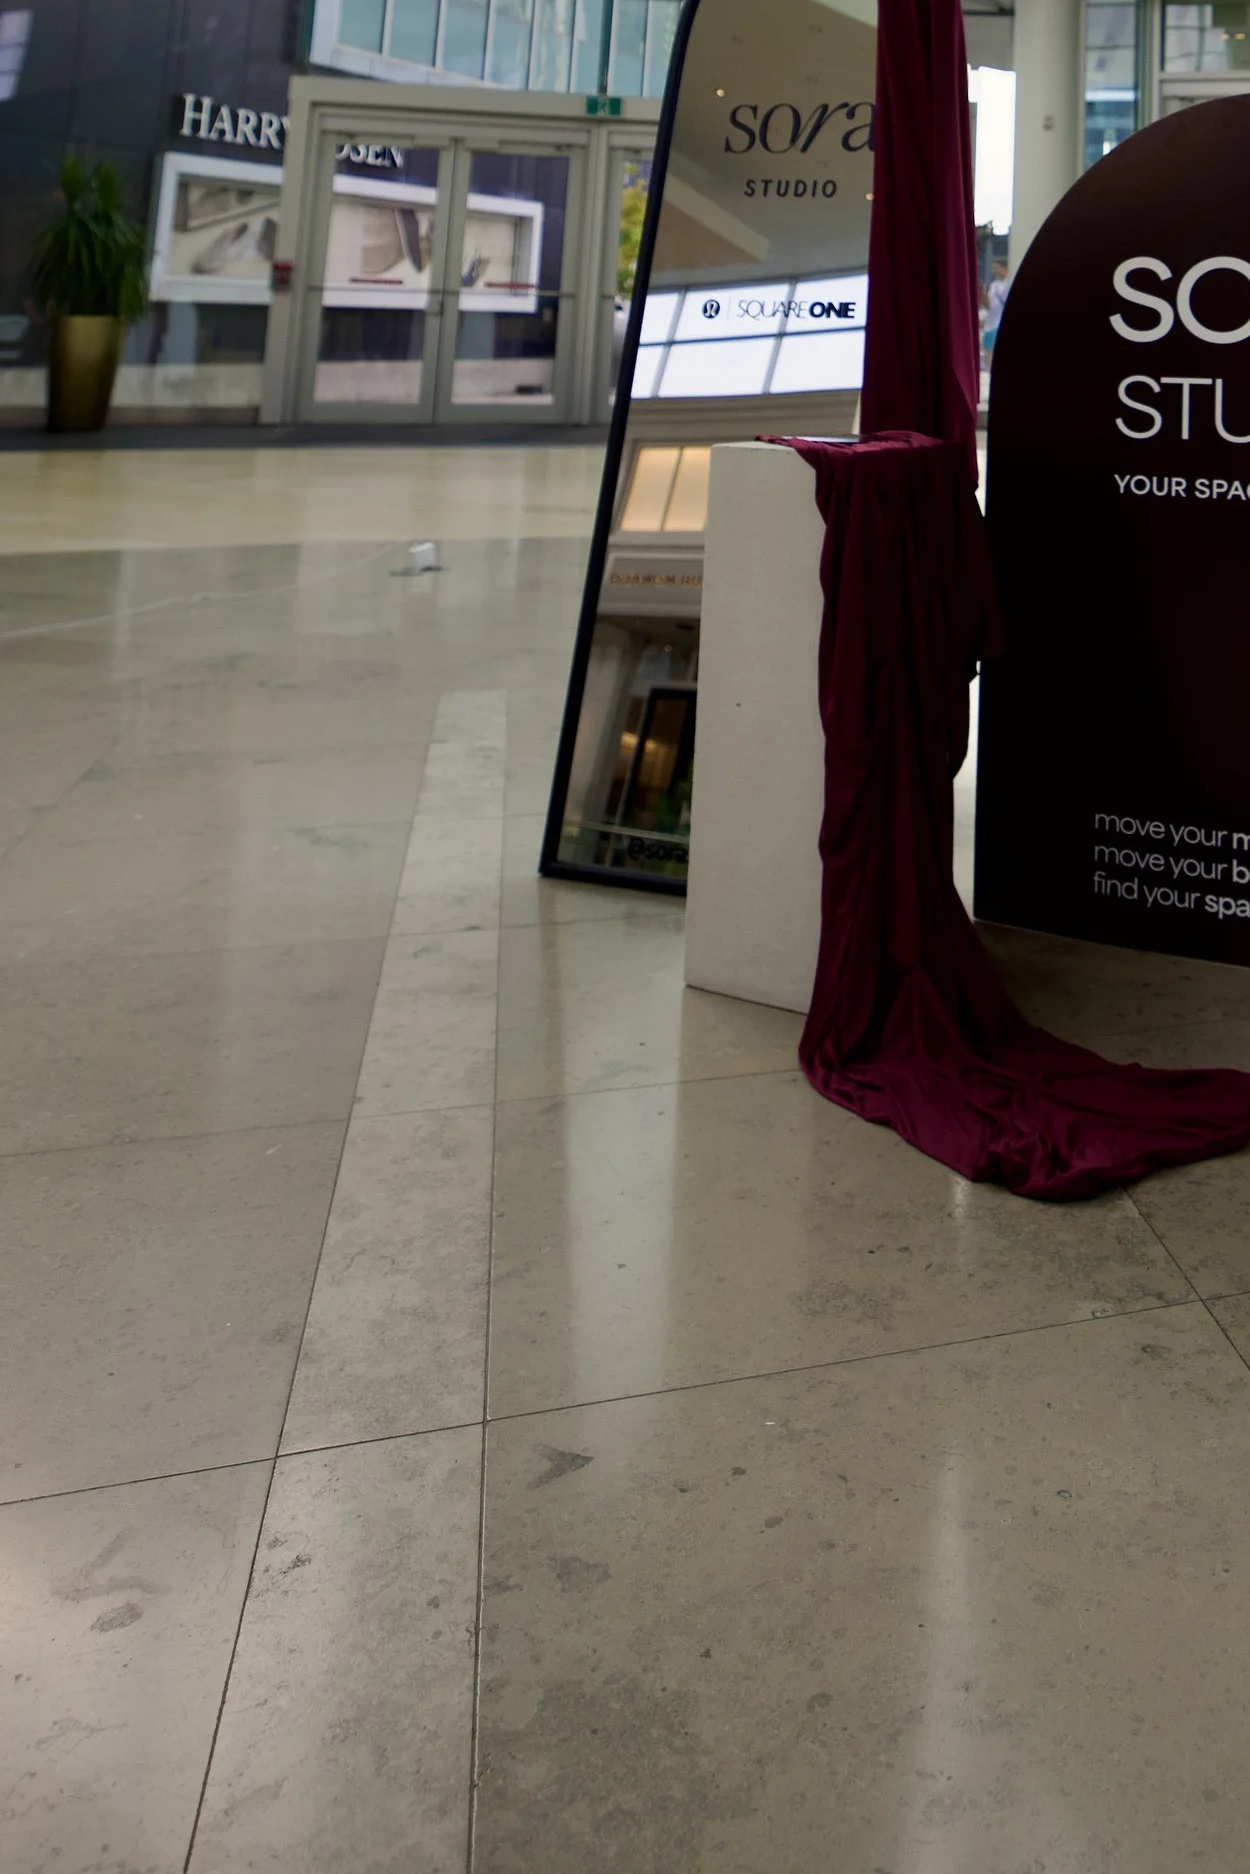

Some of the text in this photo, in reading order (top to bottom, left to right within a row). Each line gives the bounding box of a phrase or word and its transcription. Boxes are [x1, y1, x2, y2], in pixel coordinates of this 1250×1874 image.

[179, 92, 289, 150] HARR
[724, 102, 875, 154] sora
[744, 179, 837, 199] STUDIO
[1114, 474, 1187, 497] YOUR
[1094, 813, 1165, 839] move
[1169, 824, 1228, 847] your
[1094, 845, 1165, 871] move
[1169, 856, 1228, 880] your
[1093, 871, 1138, 900] find
[1143, 885, 1201, 909] your
